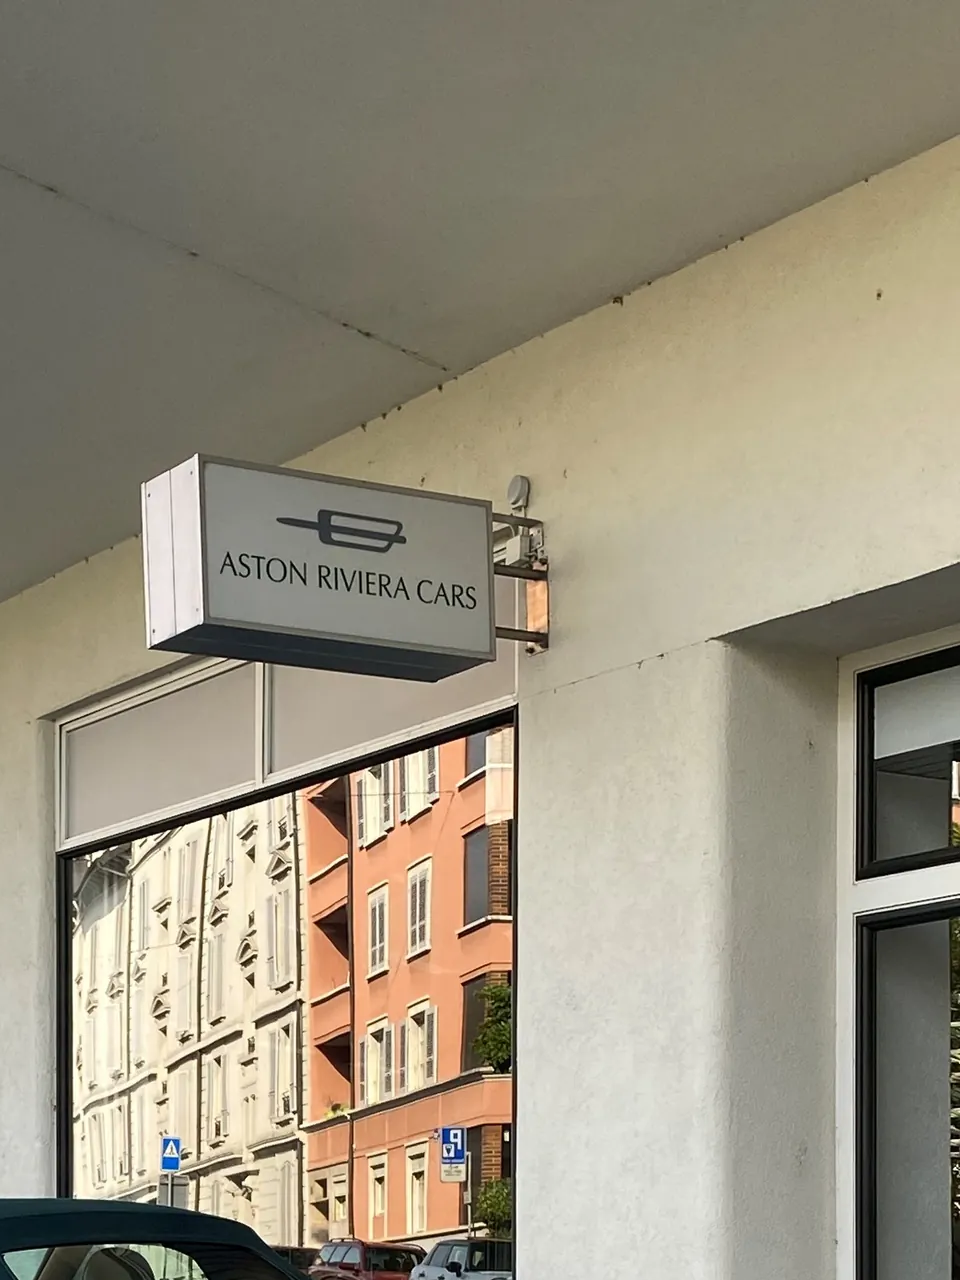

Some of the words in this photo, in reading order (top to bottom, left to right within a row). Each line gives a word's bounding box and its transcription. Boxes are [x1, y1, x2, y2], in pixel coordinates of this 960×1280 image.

[219, 551, 308, 586] ASTON
[318, 564, 410, 601] RIVIERA
[417, 579, 477, 610] CARS
